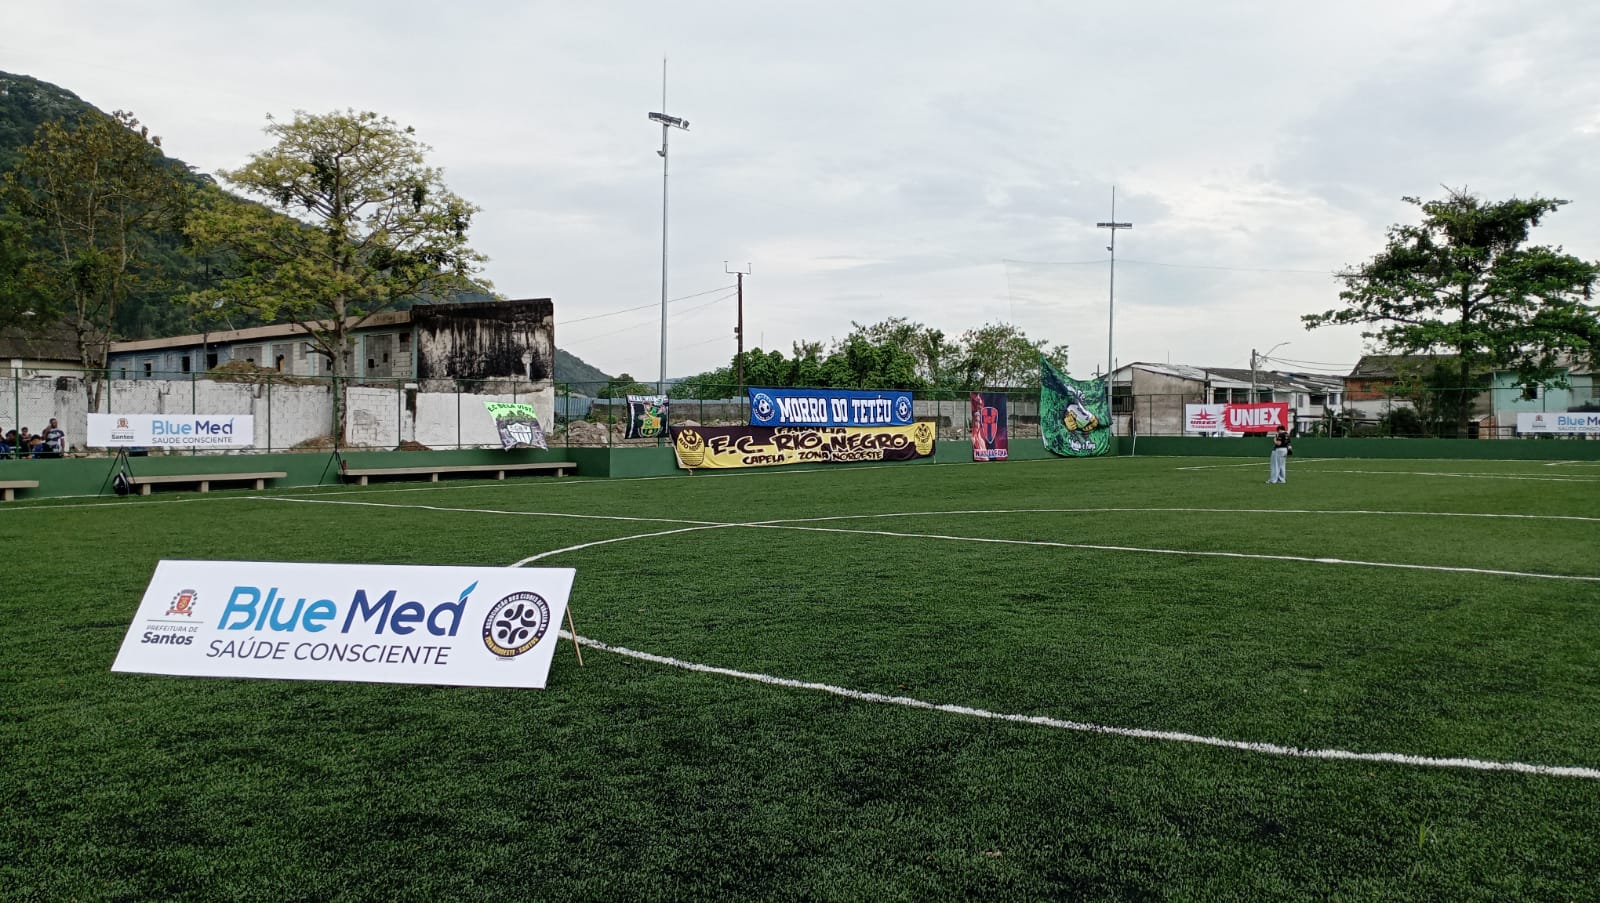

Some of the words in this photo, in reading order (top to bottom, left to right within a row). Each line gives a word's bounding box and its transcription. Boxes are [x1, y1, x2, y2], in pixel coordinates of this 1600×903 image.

[776, 397, 827, 423] MORRO
[831, 398, 848, 423] DO
[851, 394, 892, 423] TETÉU
[1230, 407, 1281, 426] UNIEX
[151, 420, 192, 435] Blue
[195, 417, 234, 435] Med
[1558, 415, 1585, 426] Blue
[182, 436, 233, 444] CONSCIENTE
[772, 432, 823, 451] RIO
[830, 432, 909, 452] NEGRO
[743, 454, 785, 465] CAPELA
[799, 450, 829, 461] ZONA
[832, 449, 884, 462] NOROESTE
[217, 586, 337, 633] Blue
[340, 580, 478, 637] Med
[146, 624, 187, 633] PREFEITURA
[140, 631, 194, 646] Santos
[206, 636, 290, 660] SAÚDE
[293, 642, 452, 665] CONSCIENTE
